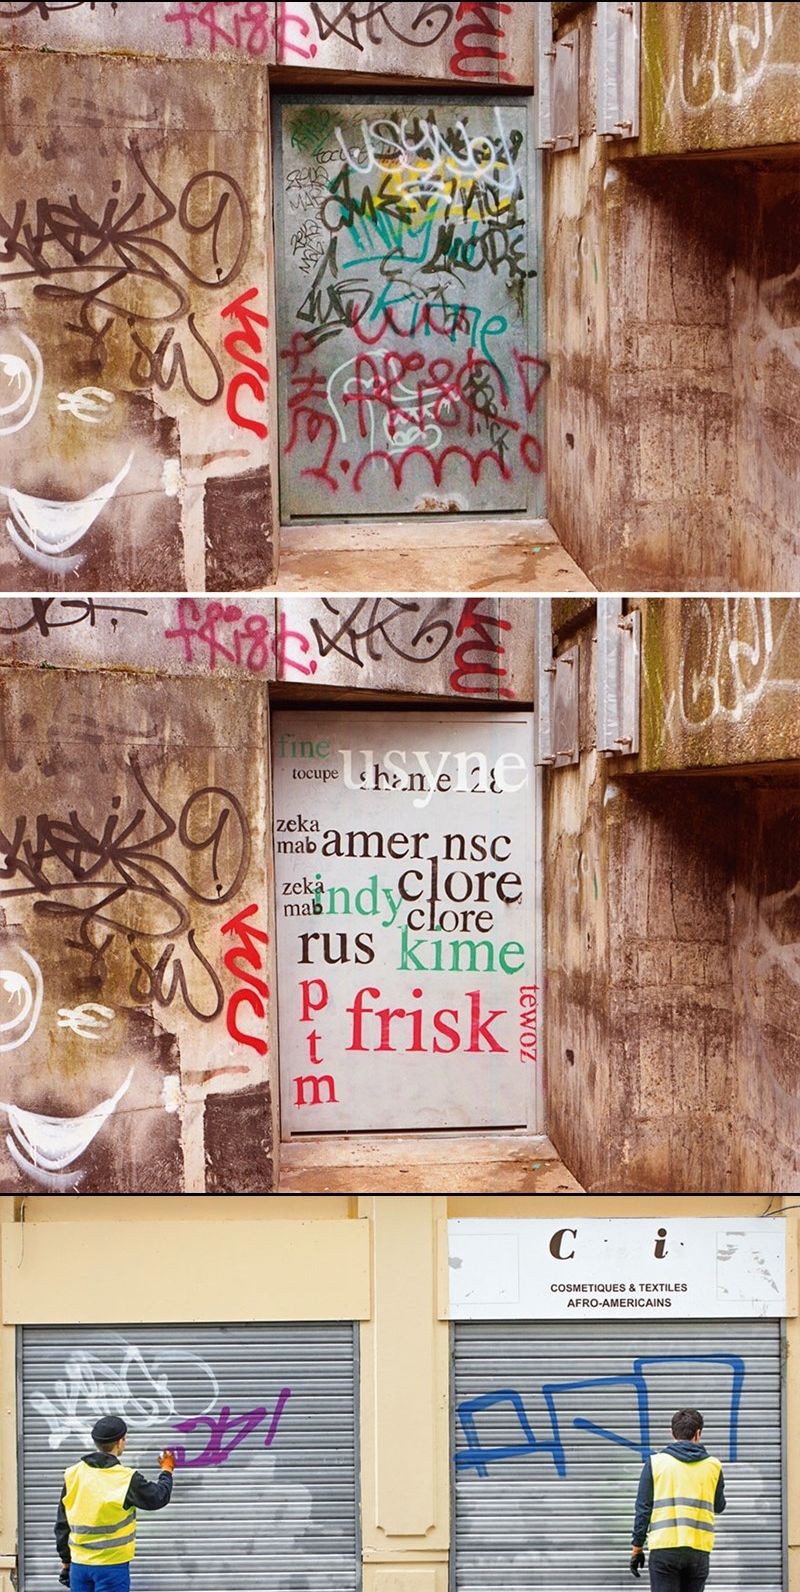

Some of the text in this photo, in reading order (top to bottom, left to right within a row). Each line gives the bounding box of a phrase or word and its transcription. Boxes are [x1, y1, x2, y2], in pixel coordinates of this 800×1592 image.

[278, 734, 331, 758] fine
[292, 768, 339, 783] tocupe
[338, 748, 529, 809] usyne
[276, 814, 320, 832] zeka
[276, 837, 317, 854] mab
[321, 829, 511, 862] amer nsc
[282, 878, 325, 896] zeka
[398, 855, 523, 903] clore
[284, 899, 324, 917] mab
[315, 873, 408, 927] indy
[407, 899, 494, 932] clore
[297, 930, 375, 965] rus
[396, 924, 526, 974] kime
[344, 987, 510, 1054] frisk
[550, 1283, 688, 1293] COSMETIQUES & TEXTILES
[567, 1298, 672, 1308] AFRO-AMERICAINS
